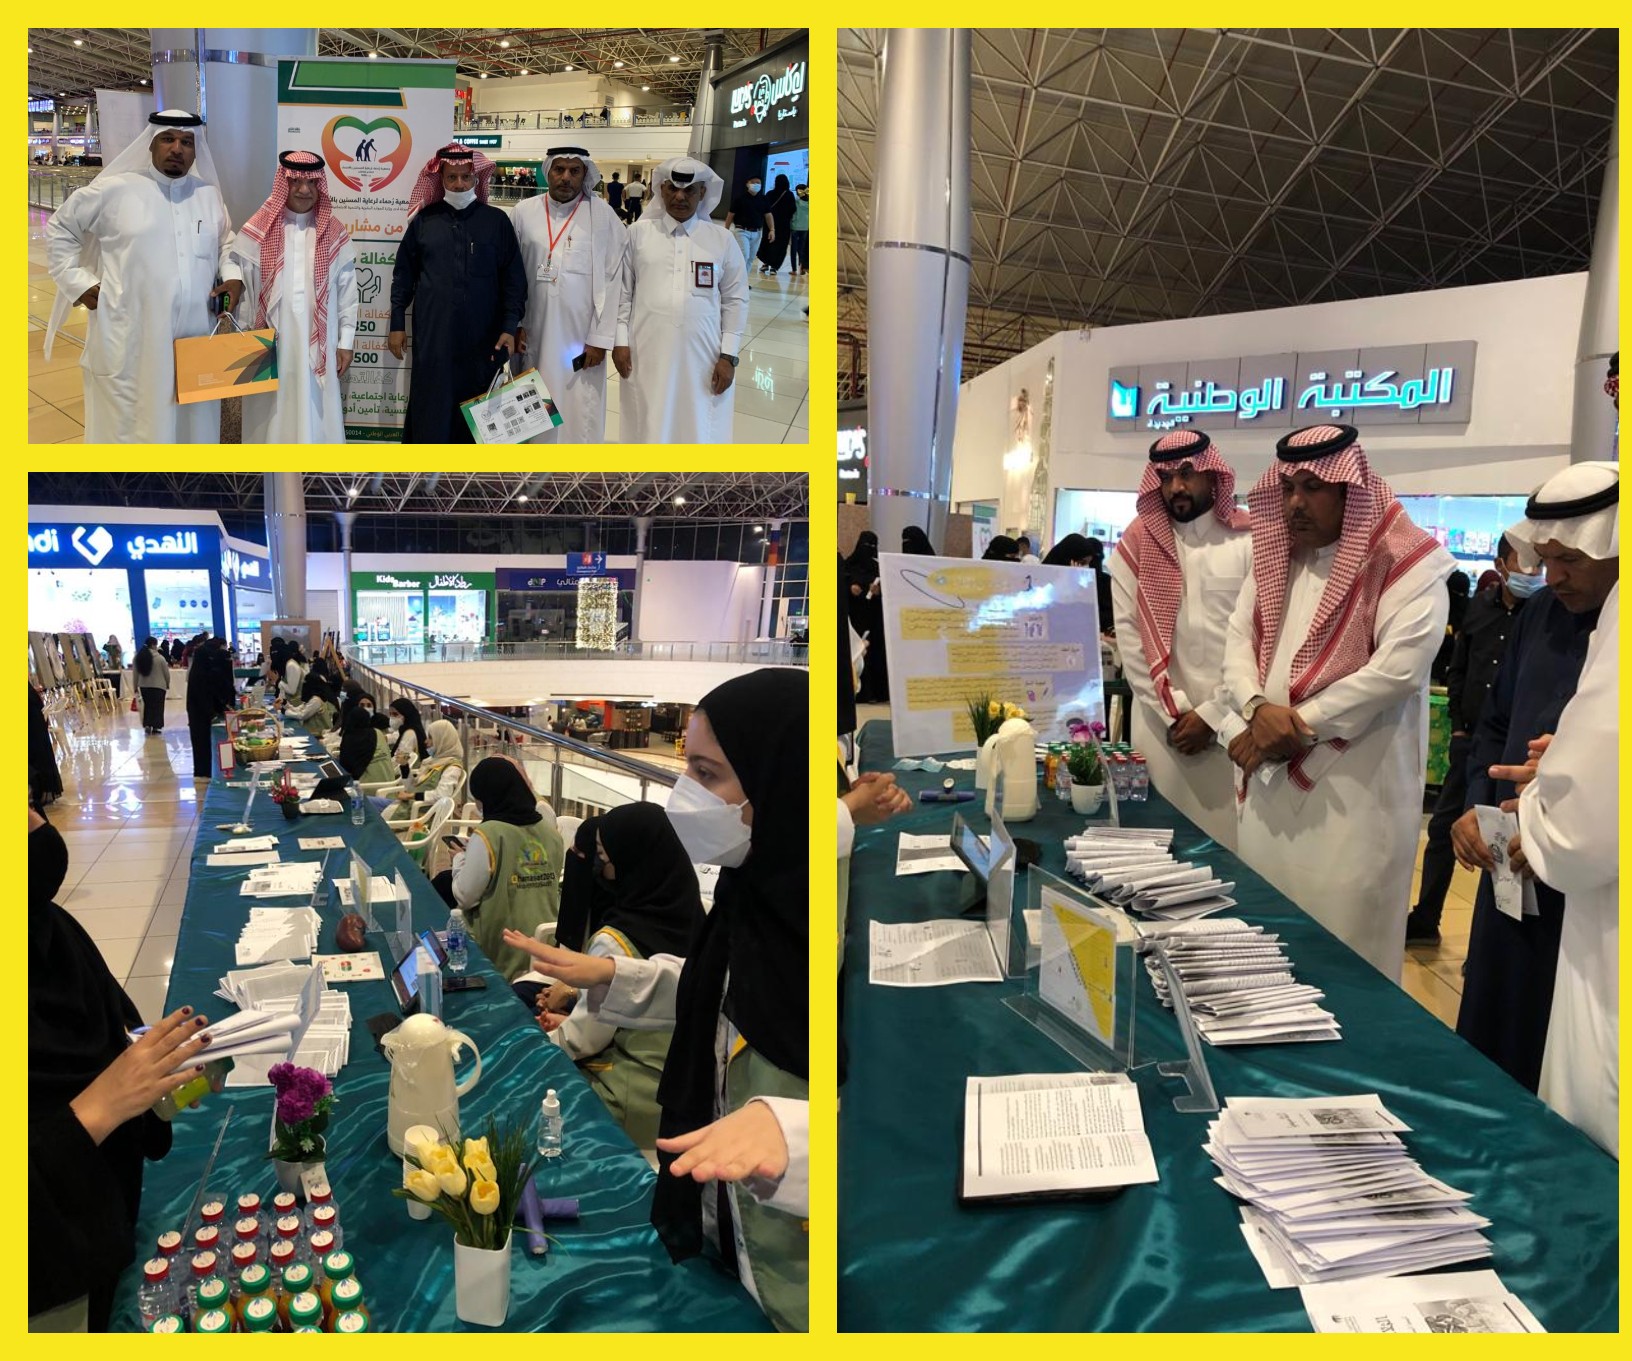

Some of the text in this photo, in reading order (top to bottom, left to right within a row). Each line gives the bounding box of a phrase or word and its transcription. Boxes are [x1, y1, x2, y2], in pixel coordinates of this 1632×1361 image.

[384, 224, 404, 235] من
[354, 353, 378, 363] 500
[1147, 367, 1454, 424] المكتبة الوطنية
[126, 531, 199, 561] النهدي
